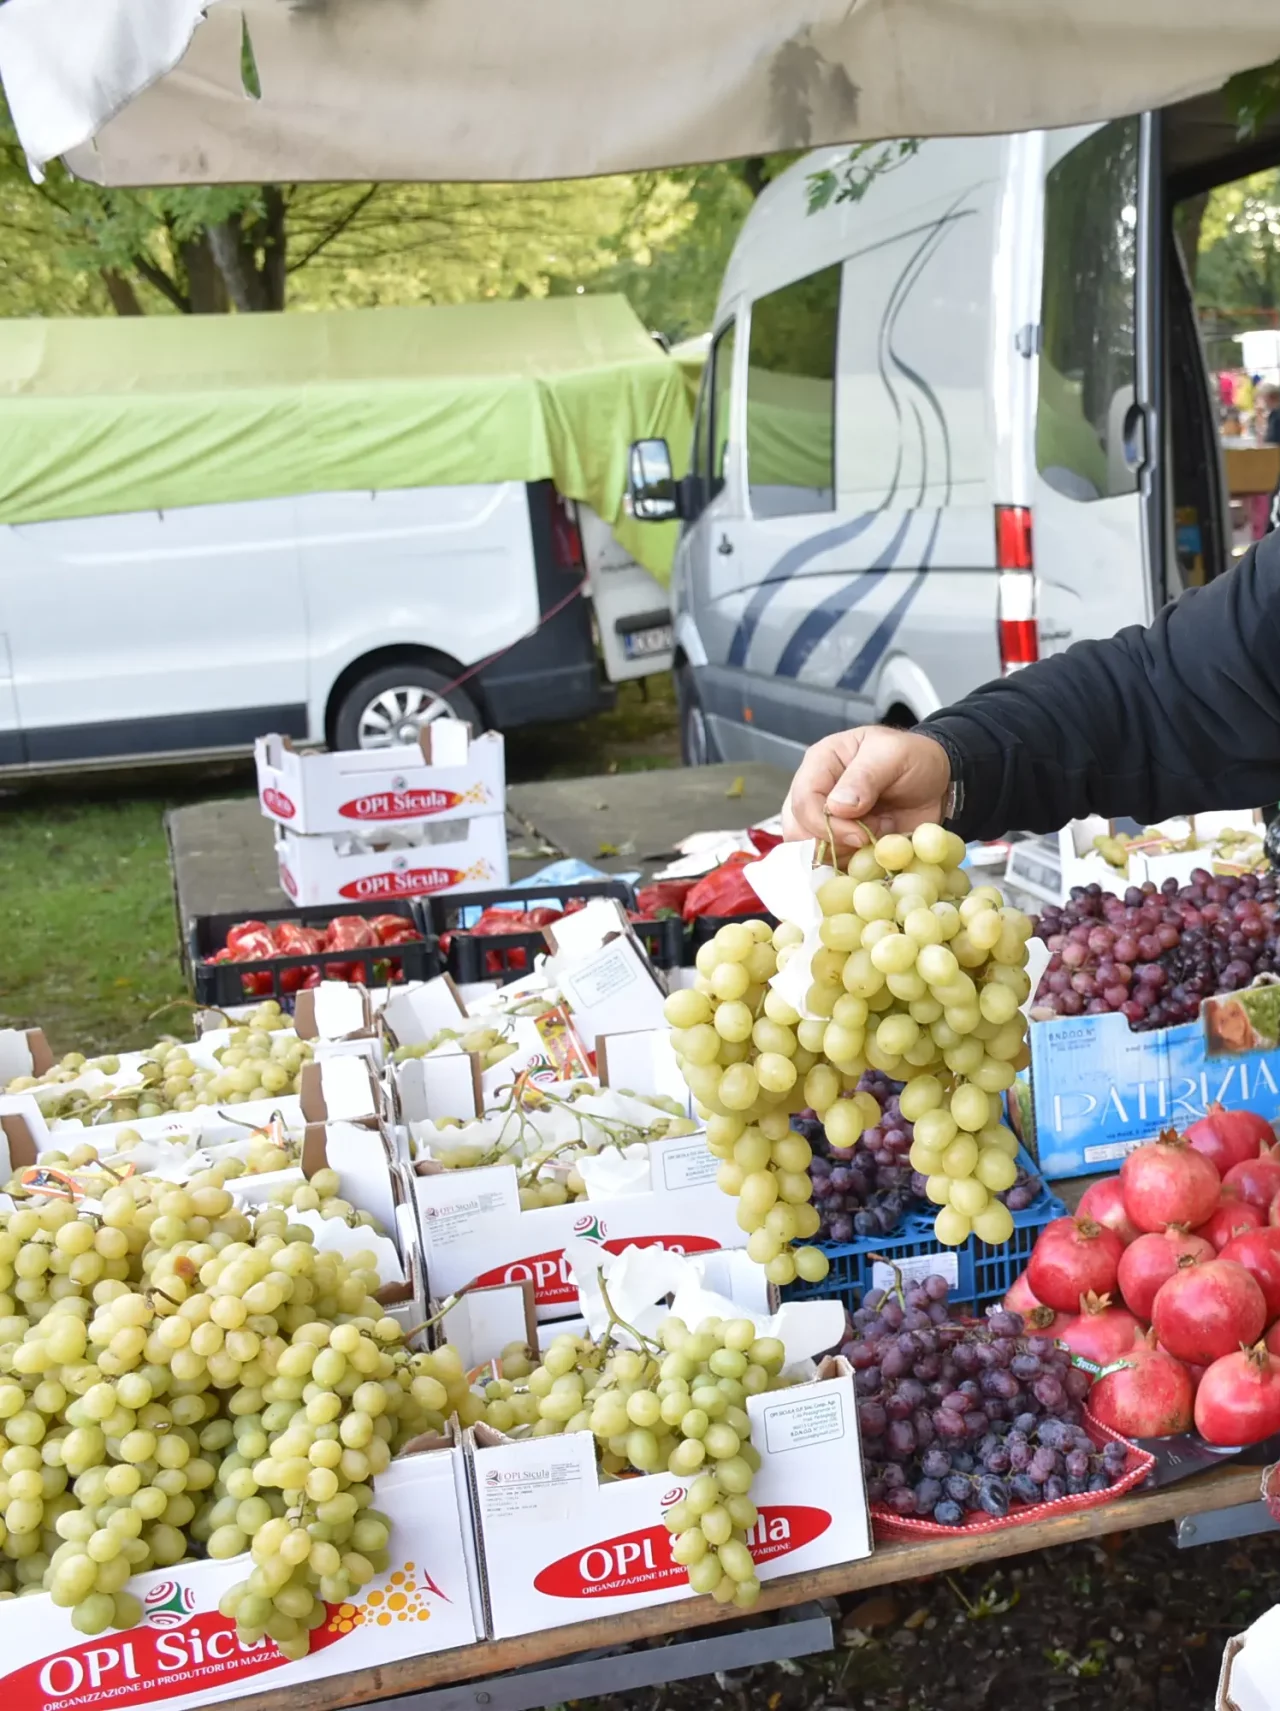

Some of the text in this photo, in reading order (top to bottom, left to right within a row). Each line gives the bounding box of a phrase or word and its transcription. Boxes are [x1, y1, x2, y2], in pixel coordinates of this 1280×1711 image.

[356, 796, 389, 814] OPI
[394, 790, 447, 810] Sicula
[356, 876, 390, 894] OPI
[394, 870, 449, 889] Sicula
[579, 1538, 658, 1582] OPI
[582, 1571, 658, 1595] ORGANIZZAZIONE
[658, 1569, 668, 1578] DI
[39, 1627, 278, 1696] OPI Sicu
[43, 1650, 284, 1711] ORGANIZZAZIONE DI PRODUTTORI DI MAZZAR
